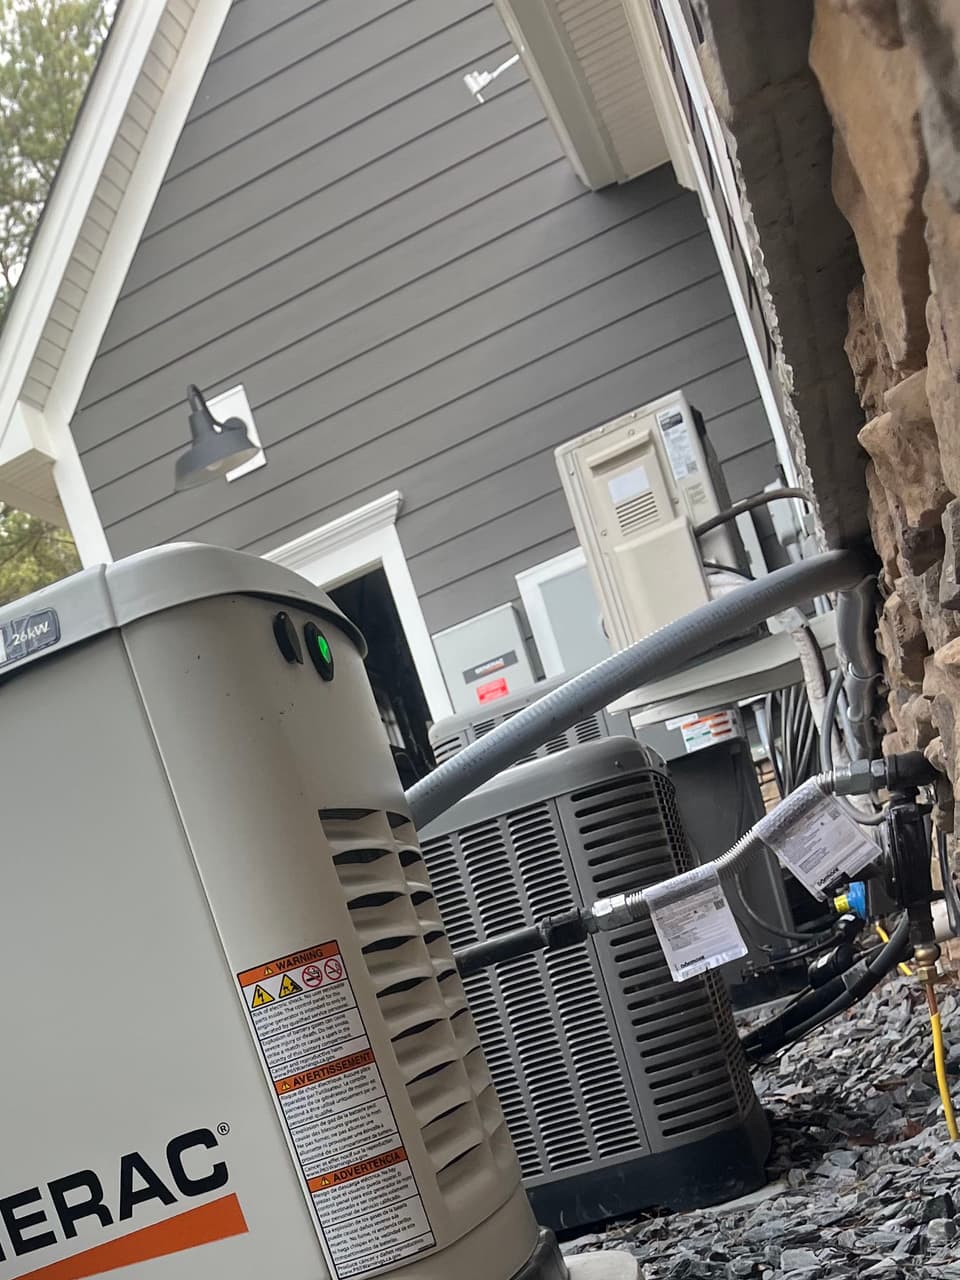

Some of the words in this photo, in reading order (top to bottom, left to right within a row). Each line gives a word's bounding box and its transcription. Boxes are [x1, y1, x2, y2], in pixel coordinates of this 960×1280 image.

[12, 621, 49, 646] 26kW
[274, 947, 324, 971] WARNING
[291, 1051, 371, 1087] AVERTISSEMENT
[331, 1150, 401, 1183] ADVERTENCIA
